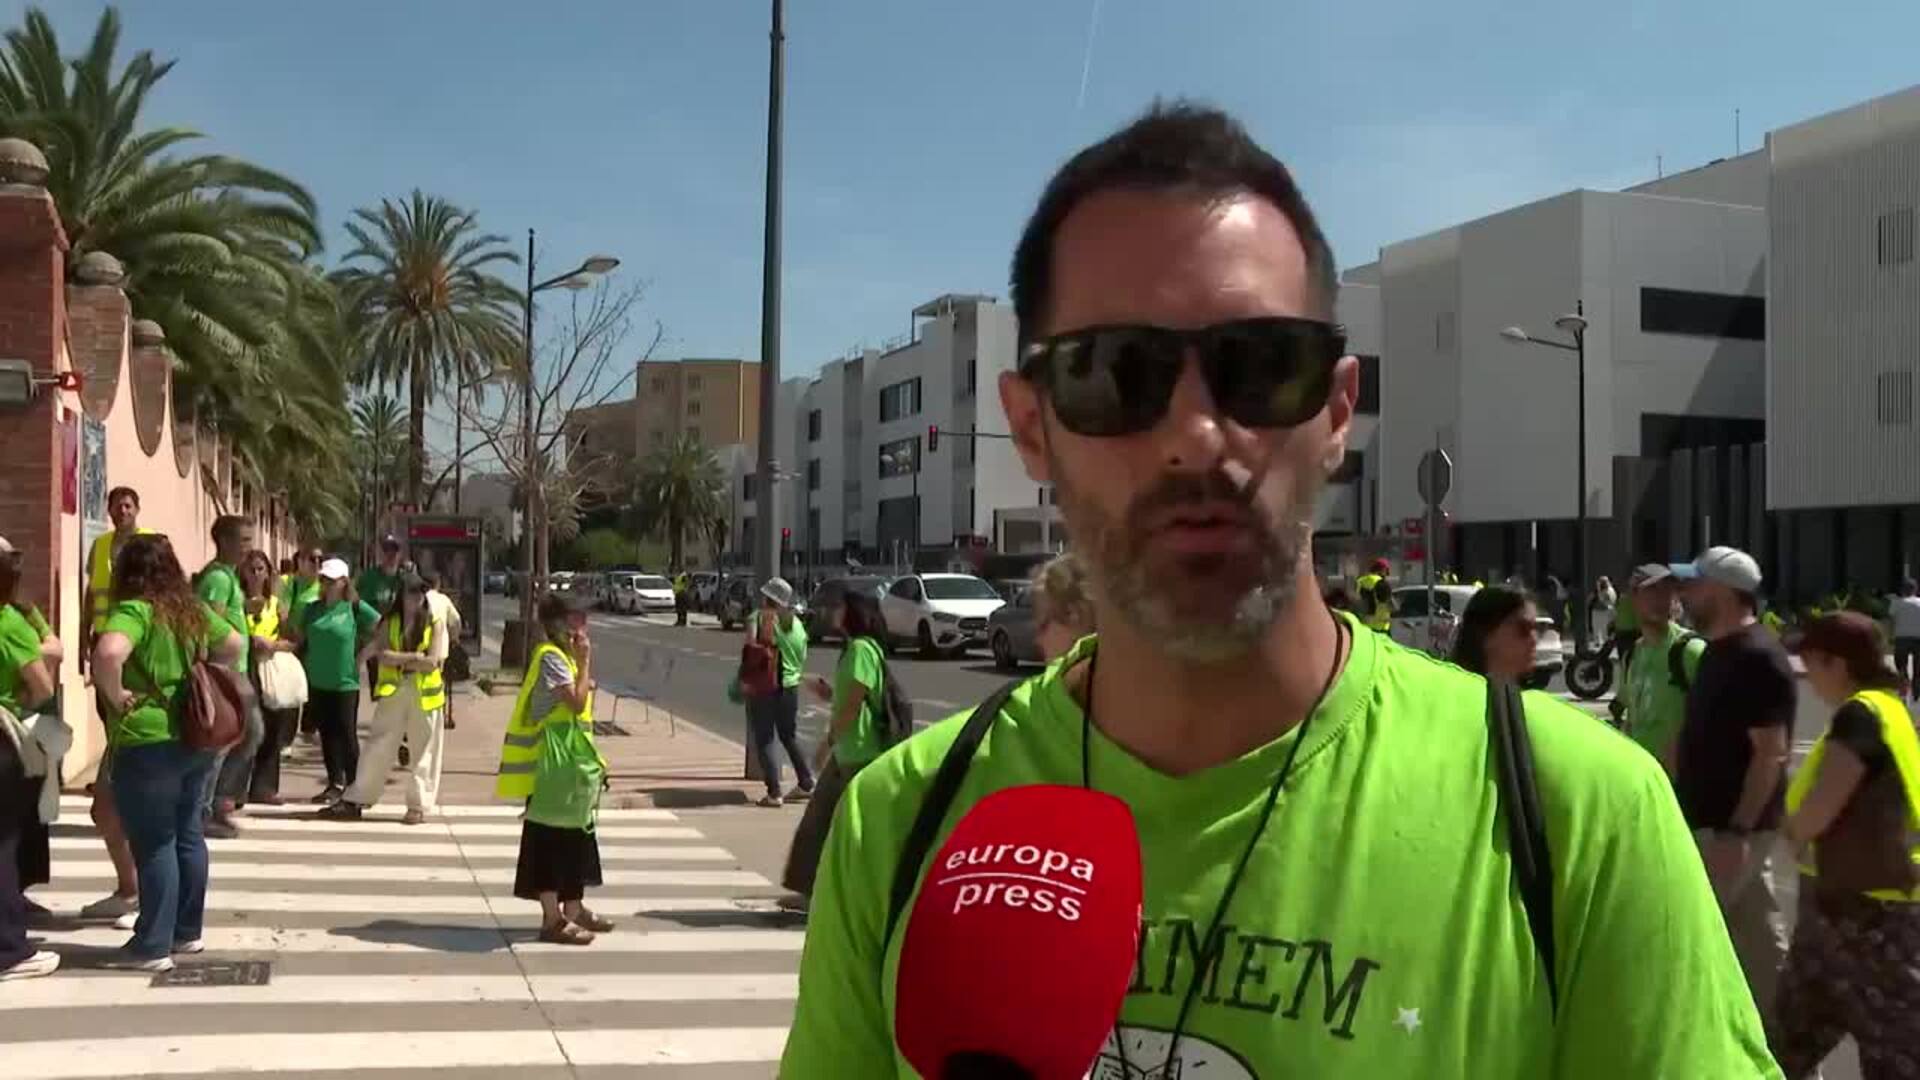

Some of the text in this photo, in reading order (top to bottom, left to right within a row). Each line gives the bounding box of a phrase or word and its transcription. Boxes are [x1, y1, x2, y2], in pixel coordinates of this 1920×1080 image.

[945, 843, 1094, 883] europa
[952, 882, 1082, 922] press
[1129, 917, 1381, 1040] IMEM
